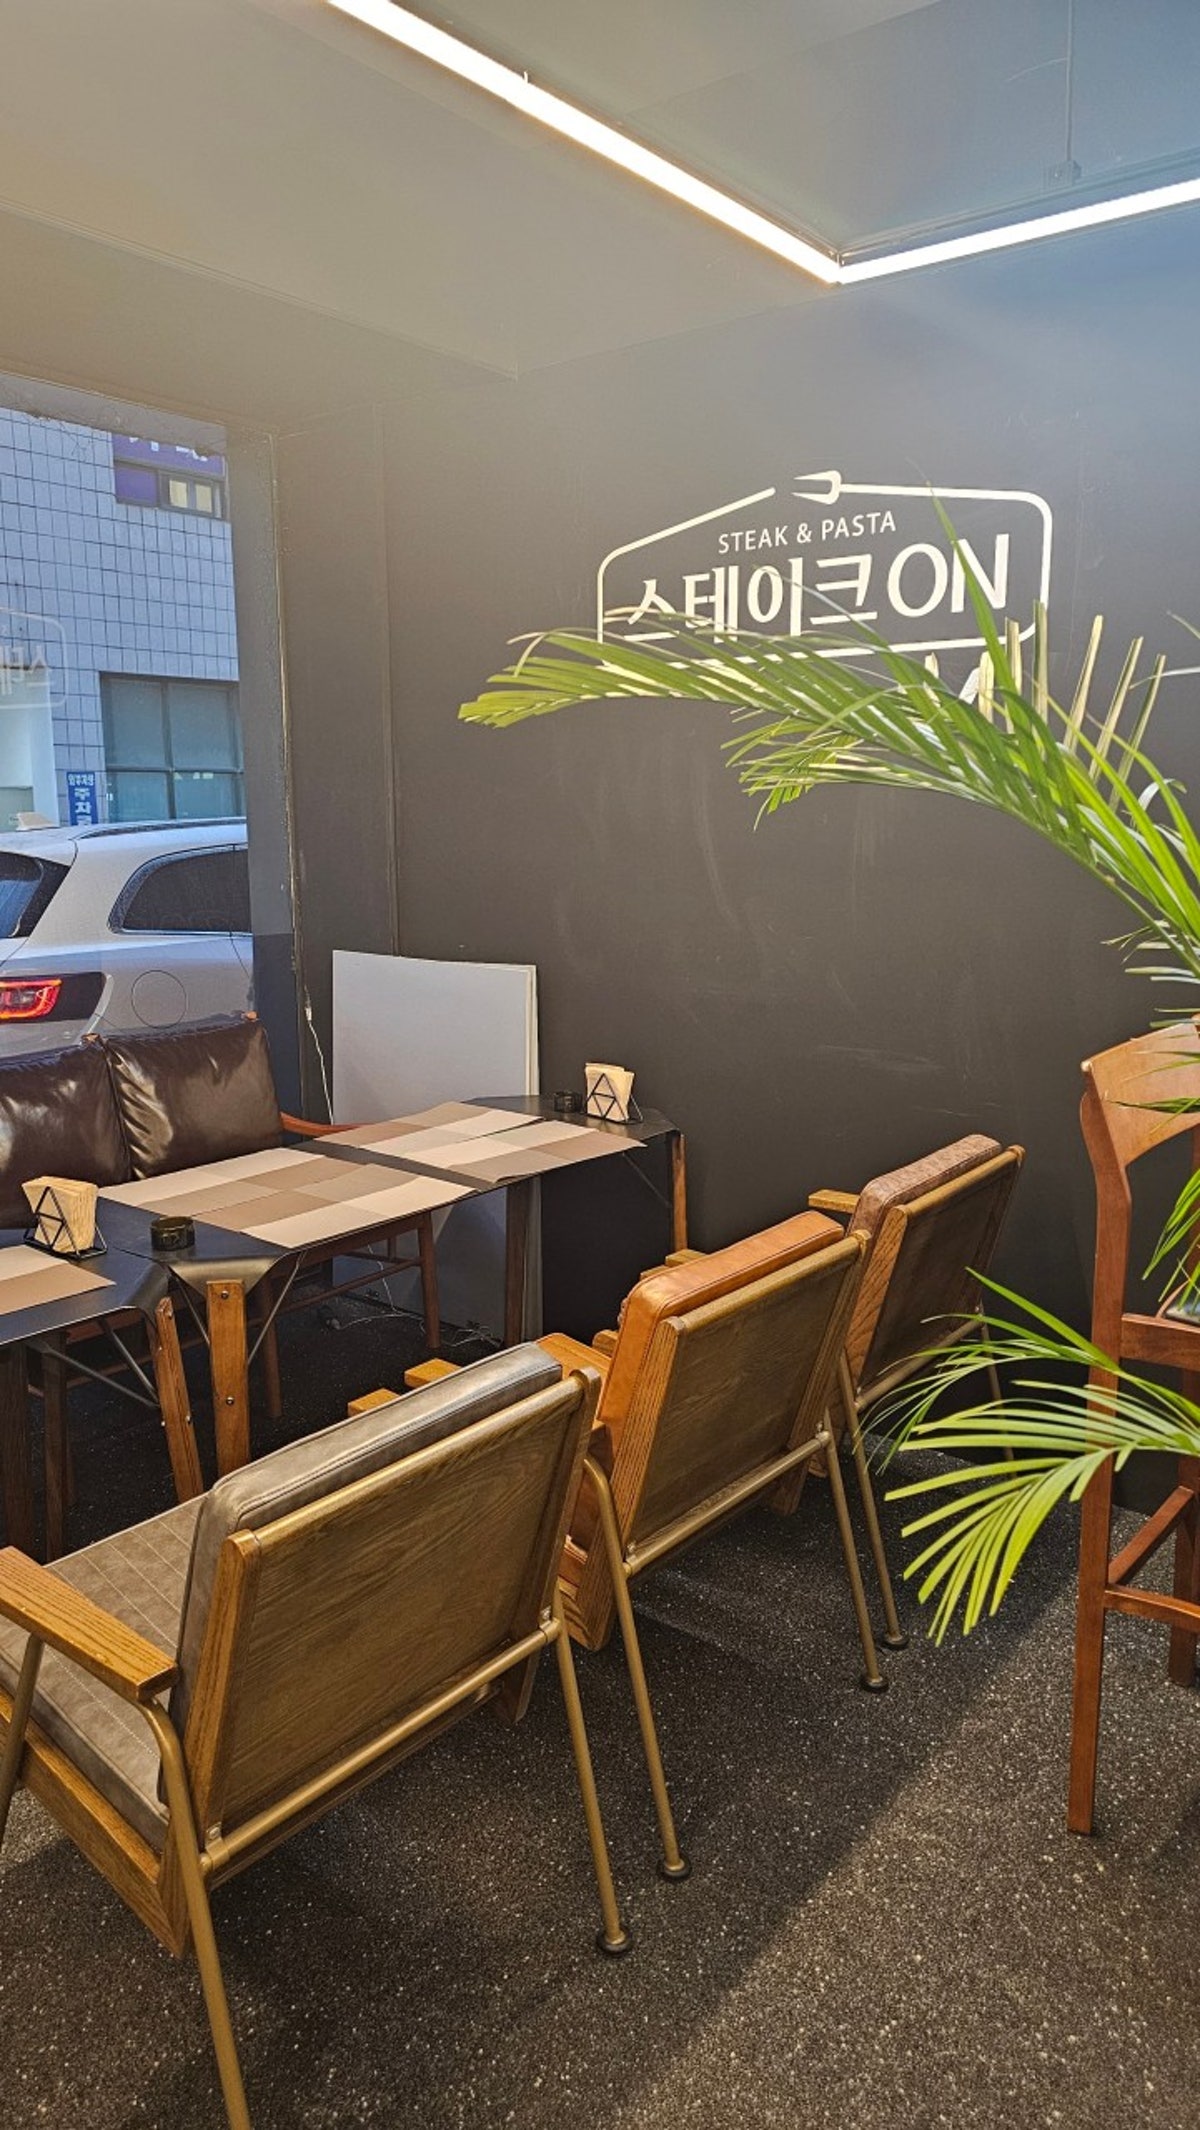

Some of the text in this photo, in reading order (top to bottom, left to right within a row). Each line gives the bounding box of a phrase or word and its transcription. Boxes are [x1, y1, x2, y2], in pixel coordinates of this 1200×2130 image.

[718, 510, 896, 554] STEAK & PASTA
[623, 533, 1009, 644] 스테이크 ON
